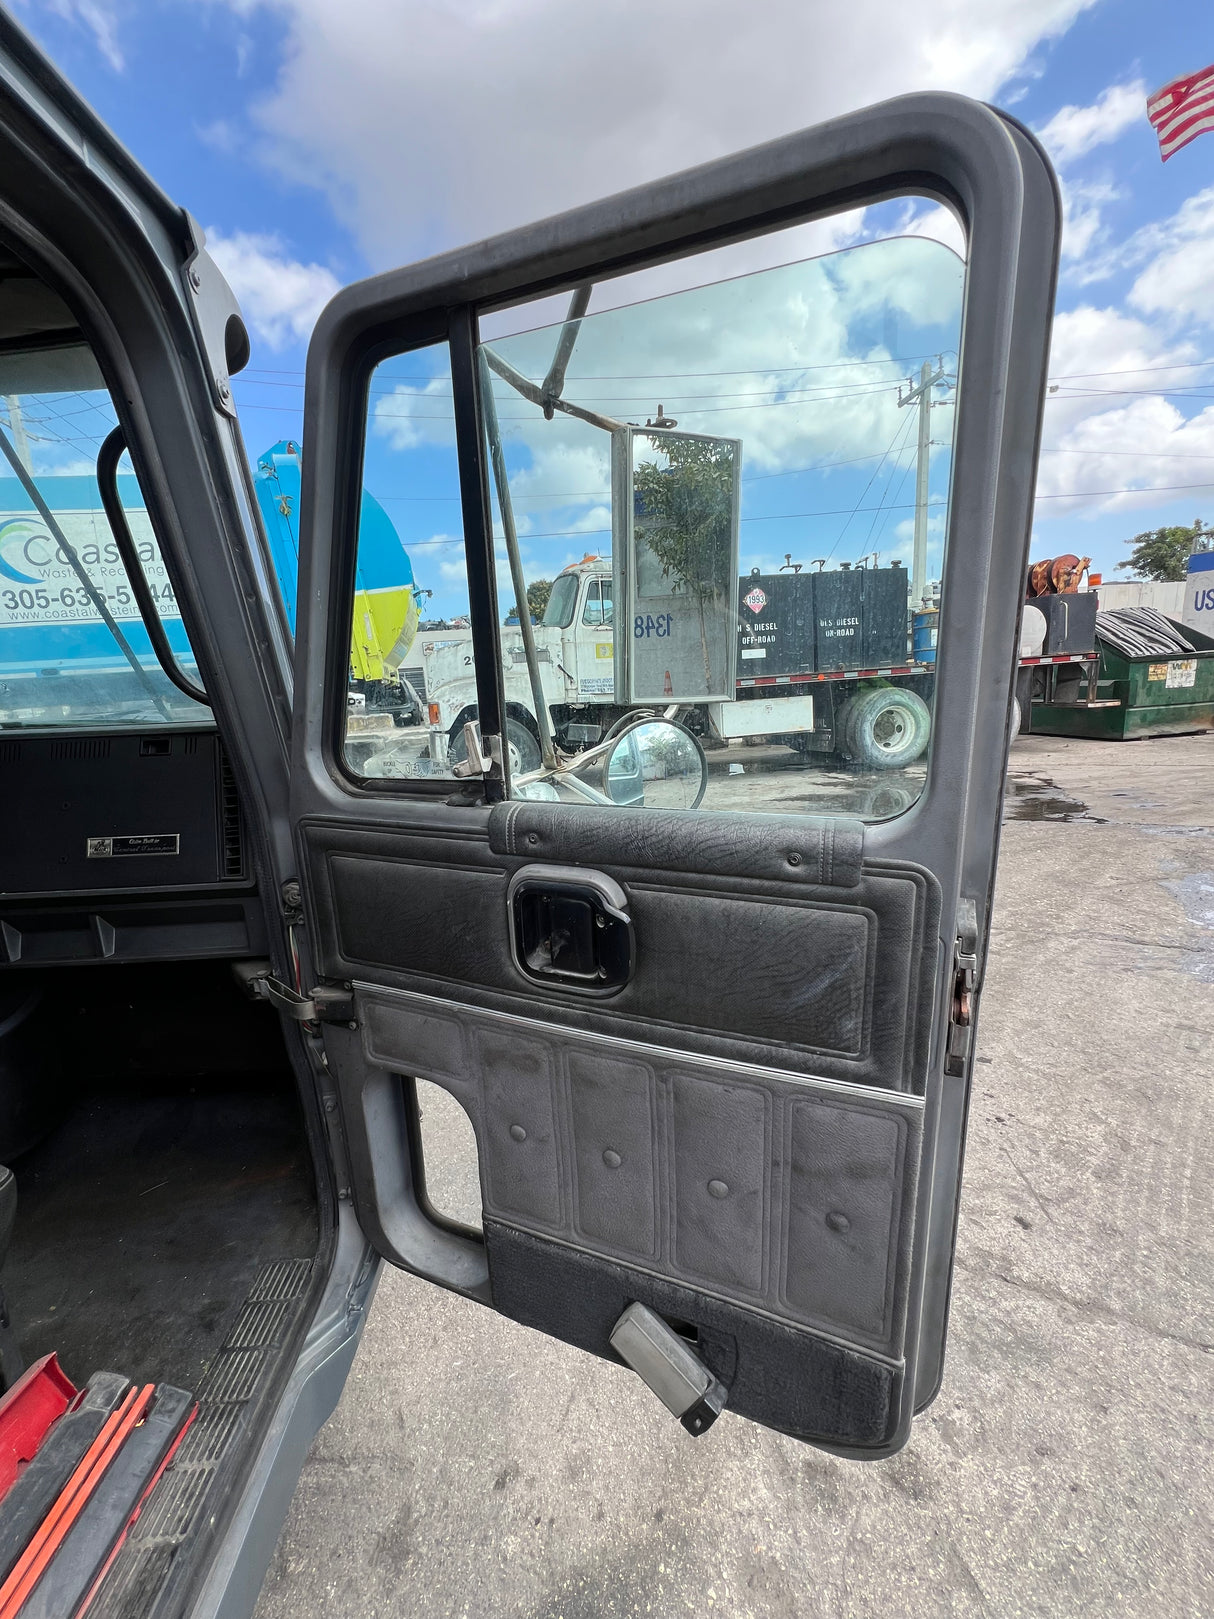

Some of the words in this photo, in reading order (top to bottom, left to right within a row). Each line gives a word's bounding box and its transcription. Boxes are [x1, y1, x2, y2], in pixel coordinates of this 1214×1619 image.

[23, 534, 163, 567] Coasa
[86, 567, 96, 577] &
[101, 564, 165, 577] Recing
[2, 582, 175, 610] 305-635-544
[748, 595, 765, 604] 1993
[754, 622, 778, 631] DIESEL
[836, 617, 860, 626] DIESEL
[742, 635, 776, 645] OFF-ROAD
